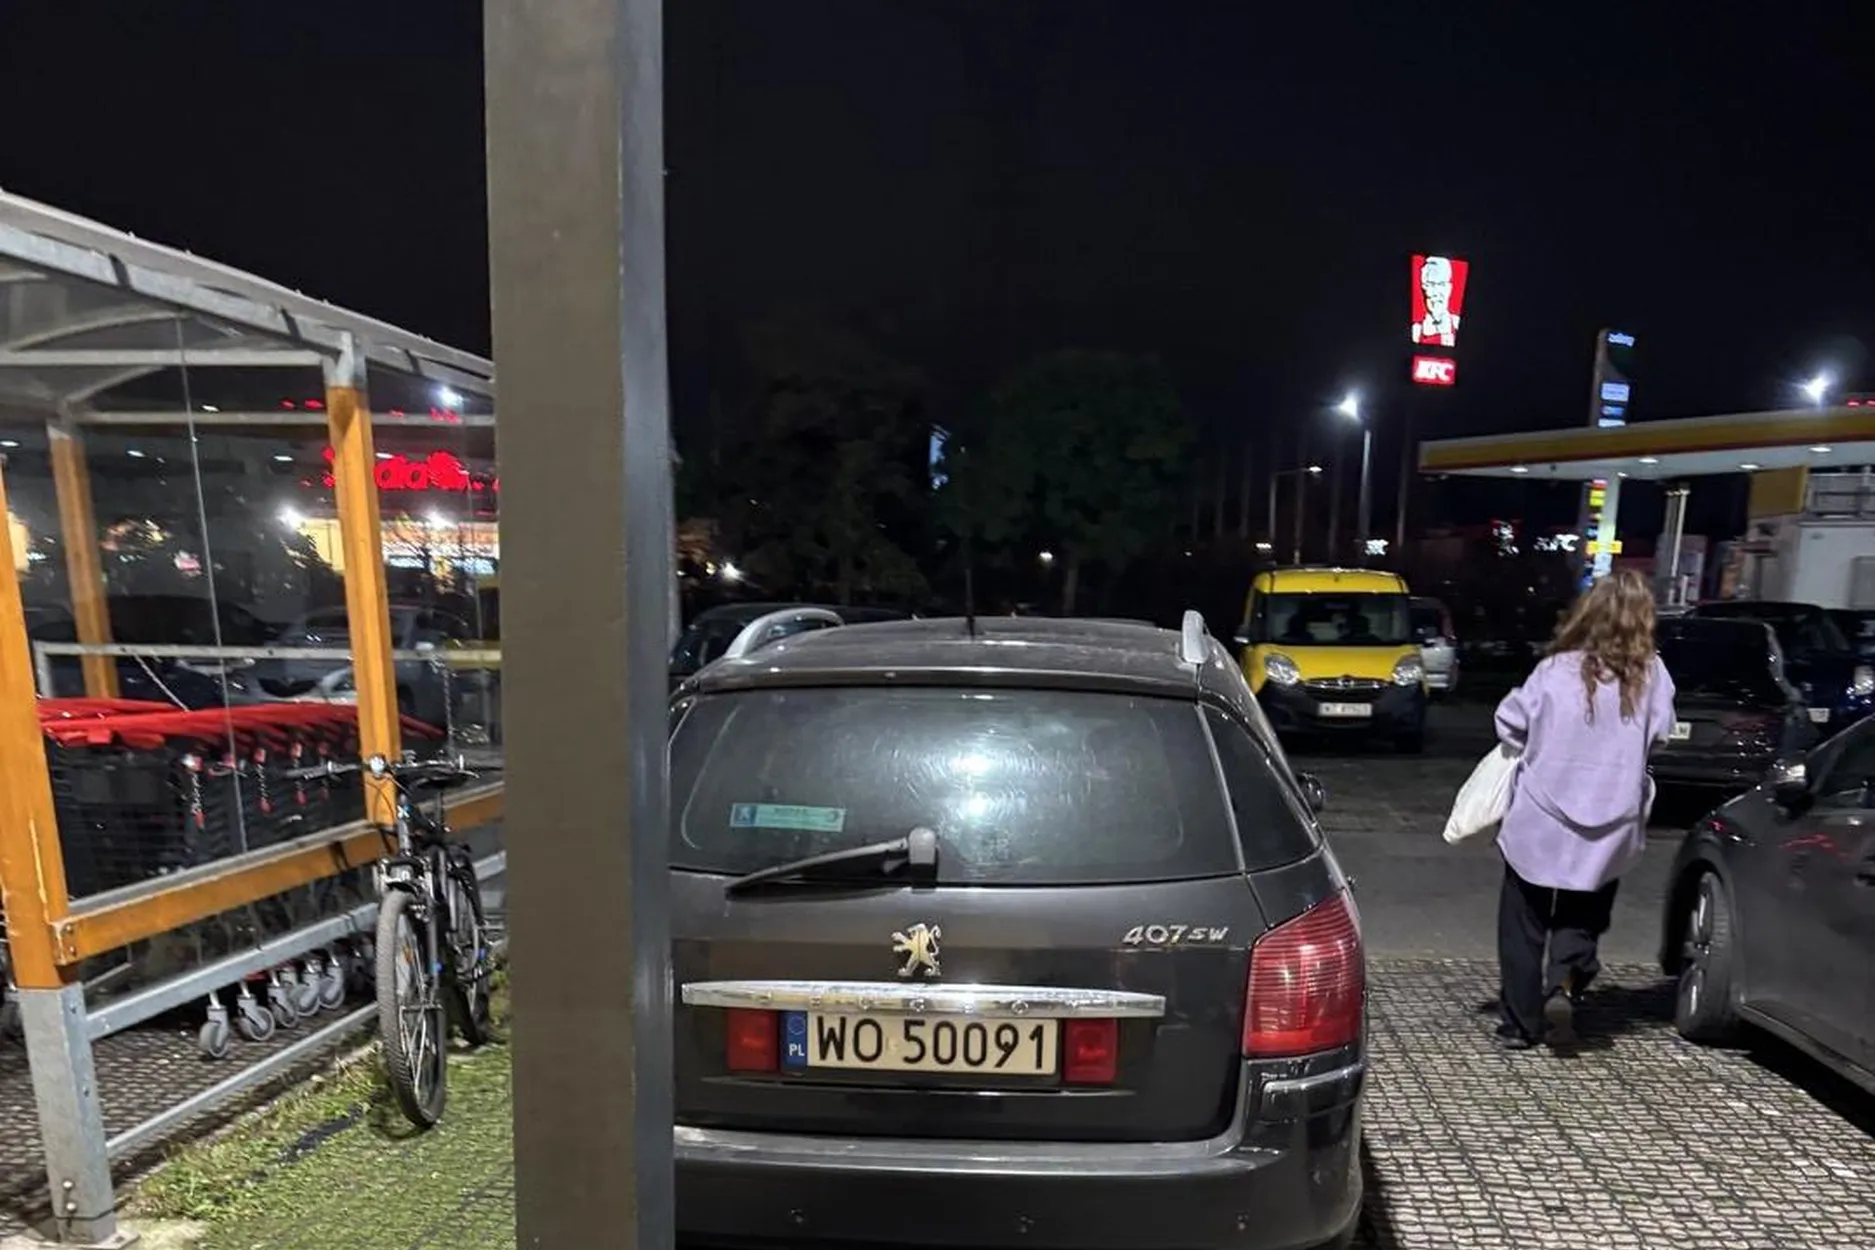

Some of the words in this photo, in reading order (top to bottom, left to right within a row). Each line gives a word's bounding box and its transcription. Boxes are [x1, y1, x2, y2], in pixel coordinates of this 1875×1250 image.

[1415, 360, 1454, 381] KFC
[1121, 924, 1188, 945] 407
[789, 1044, 805, 1057] PL
[816, 1015, 884, 1063] WO
[902, 1019, 1045, 1070] 50091
